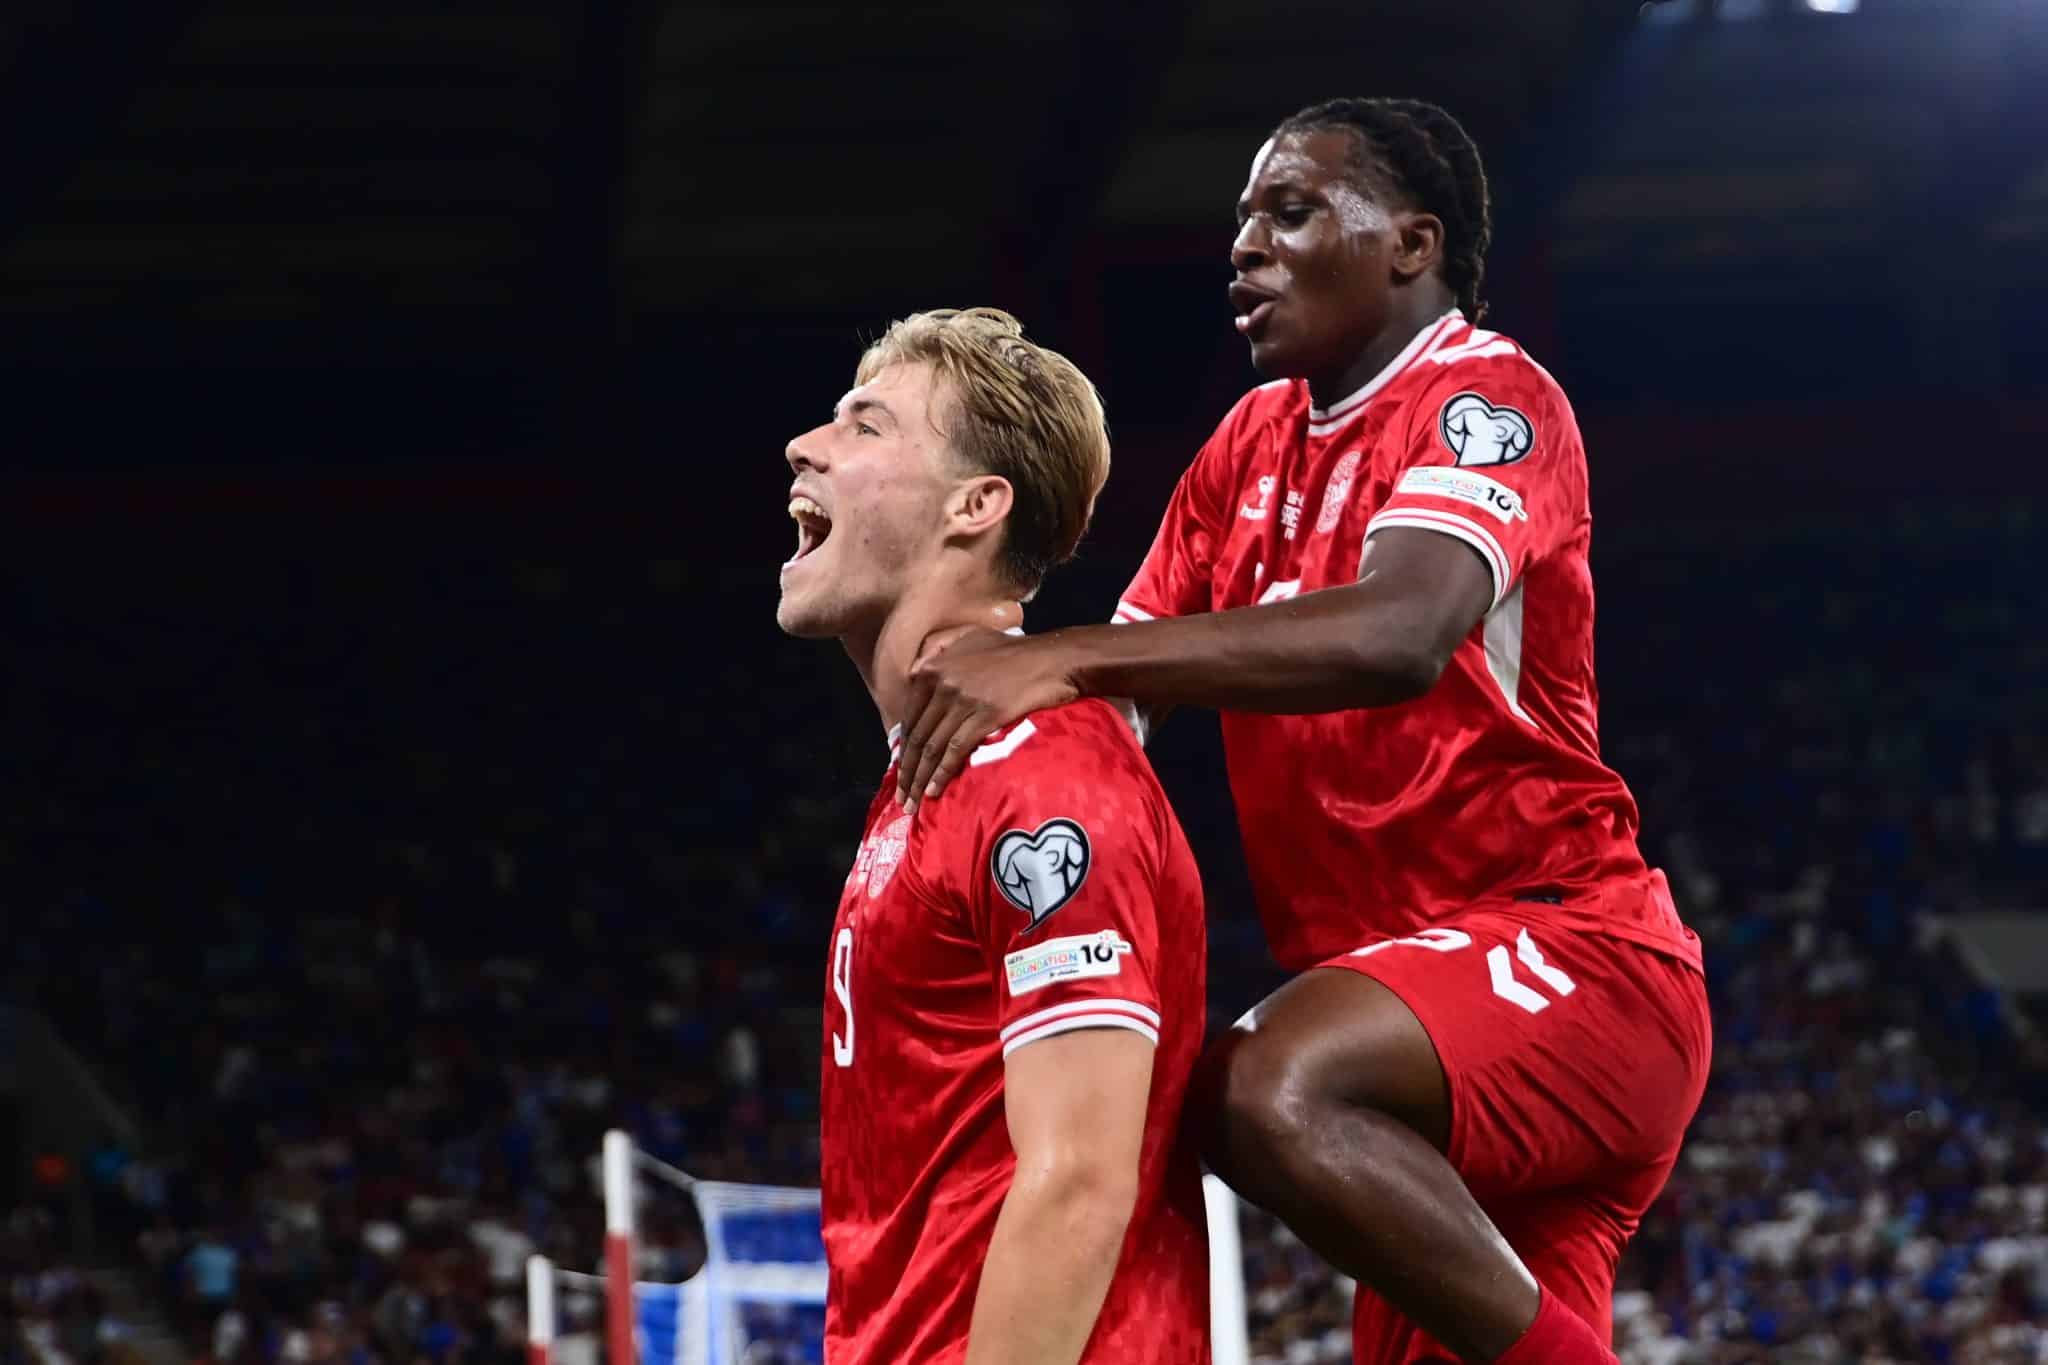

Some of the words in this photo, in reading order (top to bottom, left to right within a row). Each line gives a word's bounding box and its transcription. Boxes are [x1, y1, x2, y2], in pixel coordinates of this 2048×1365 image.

[1487, 486, 1514, 512] 10
[1080, 943, 1114, 965] 10
[832, 928, 854, 1067] 9
